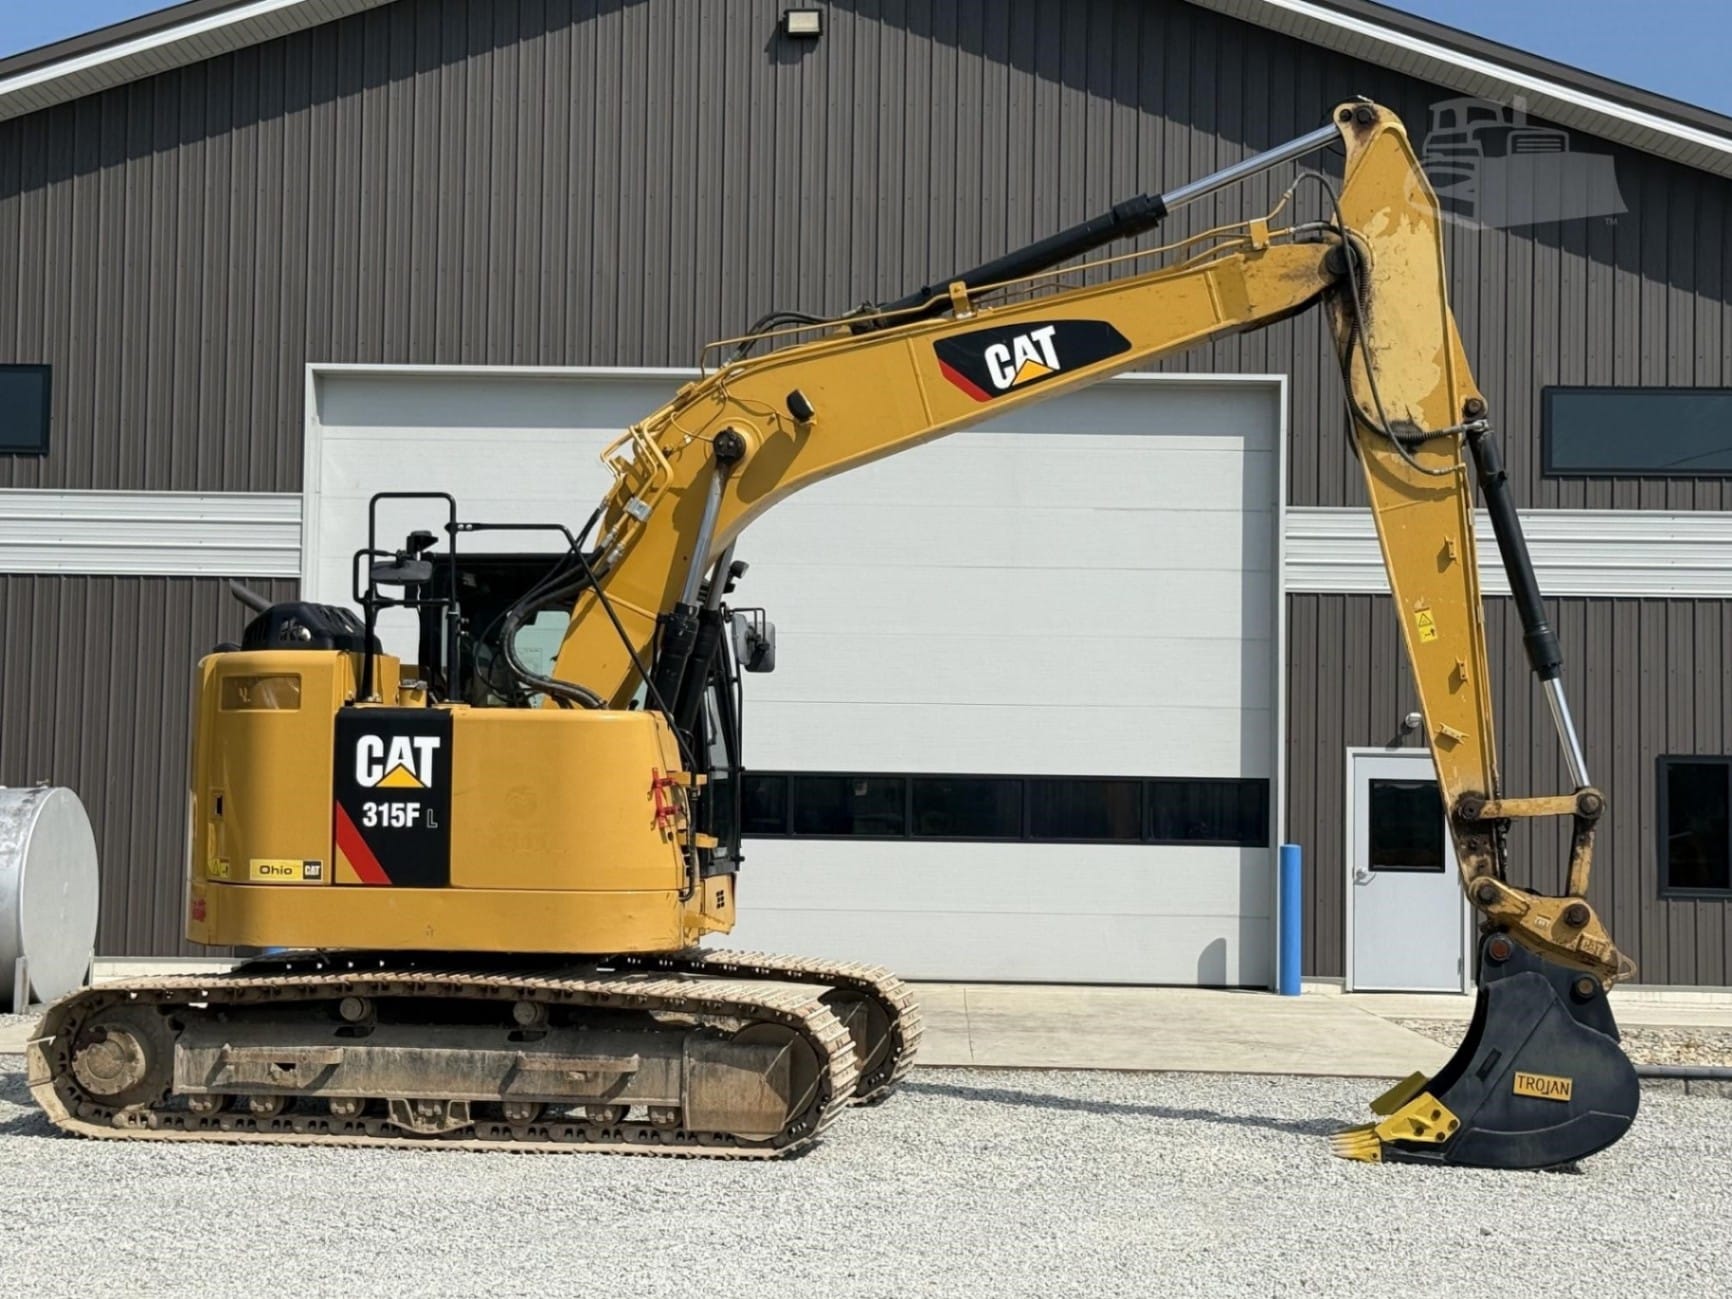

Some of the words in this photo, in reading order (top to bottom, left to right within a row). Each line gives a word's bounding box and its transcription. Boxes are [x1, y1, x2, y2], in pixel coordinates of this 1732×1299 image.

[984, 325, 1061, 389] CAT
[356, 734, 440, 788] CAT
[362, 802, 420, 827] 315F
[426, 808, 438, 828] L
[259, 865, 293, 875] Ohio
[304, 865, 320, 875] CAT
[1518, 1075, 1570, 1096] TROJAN
